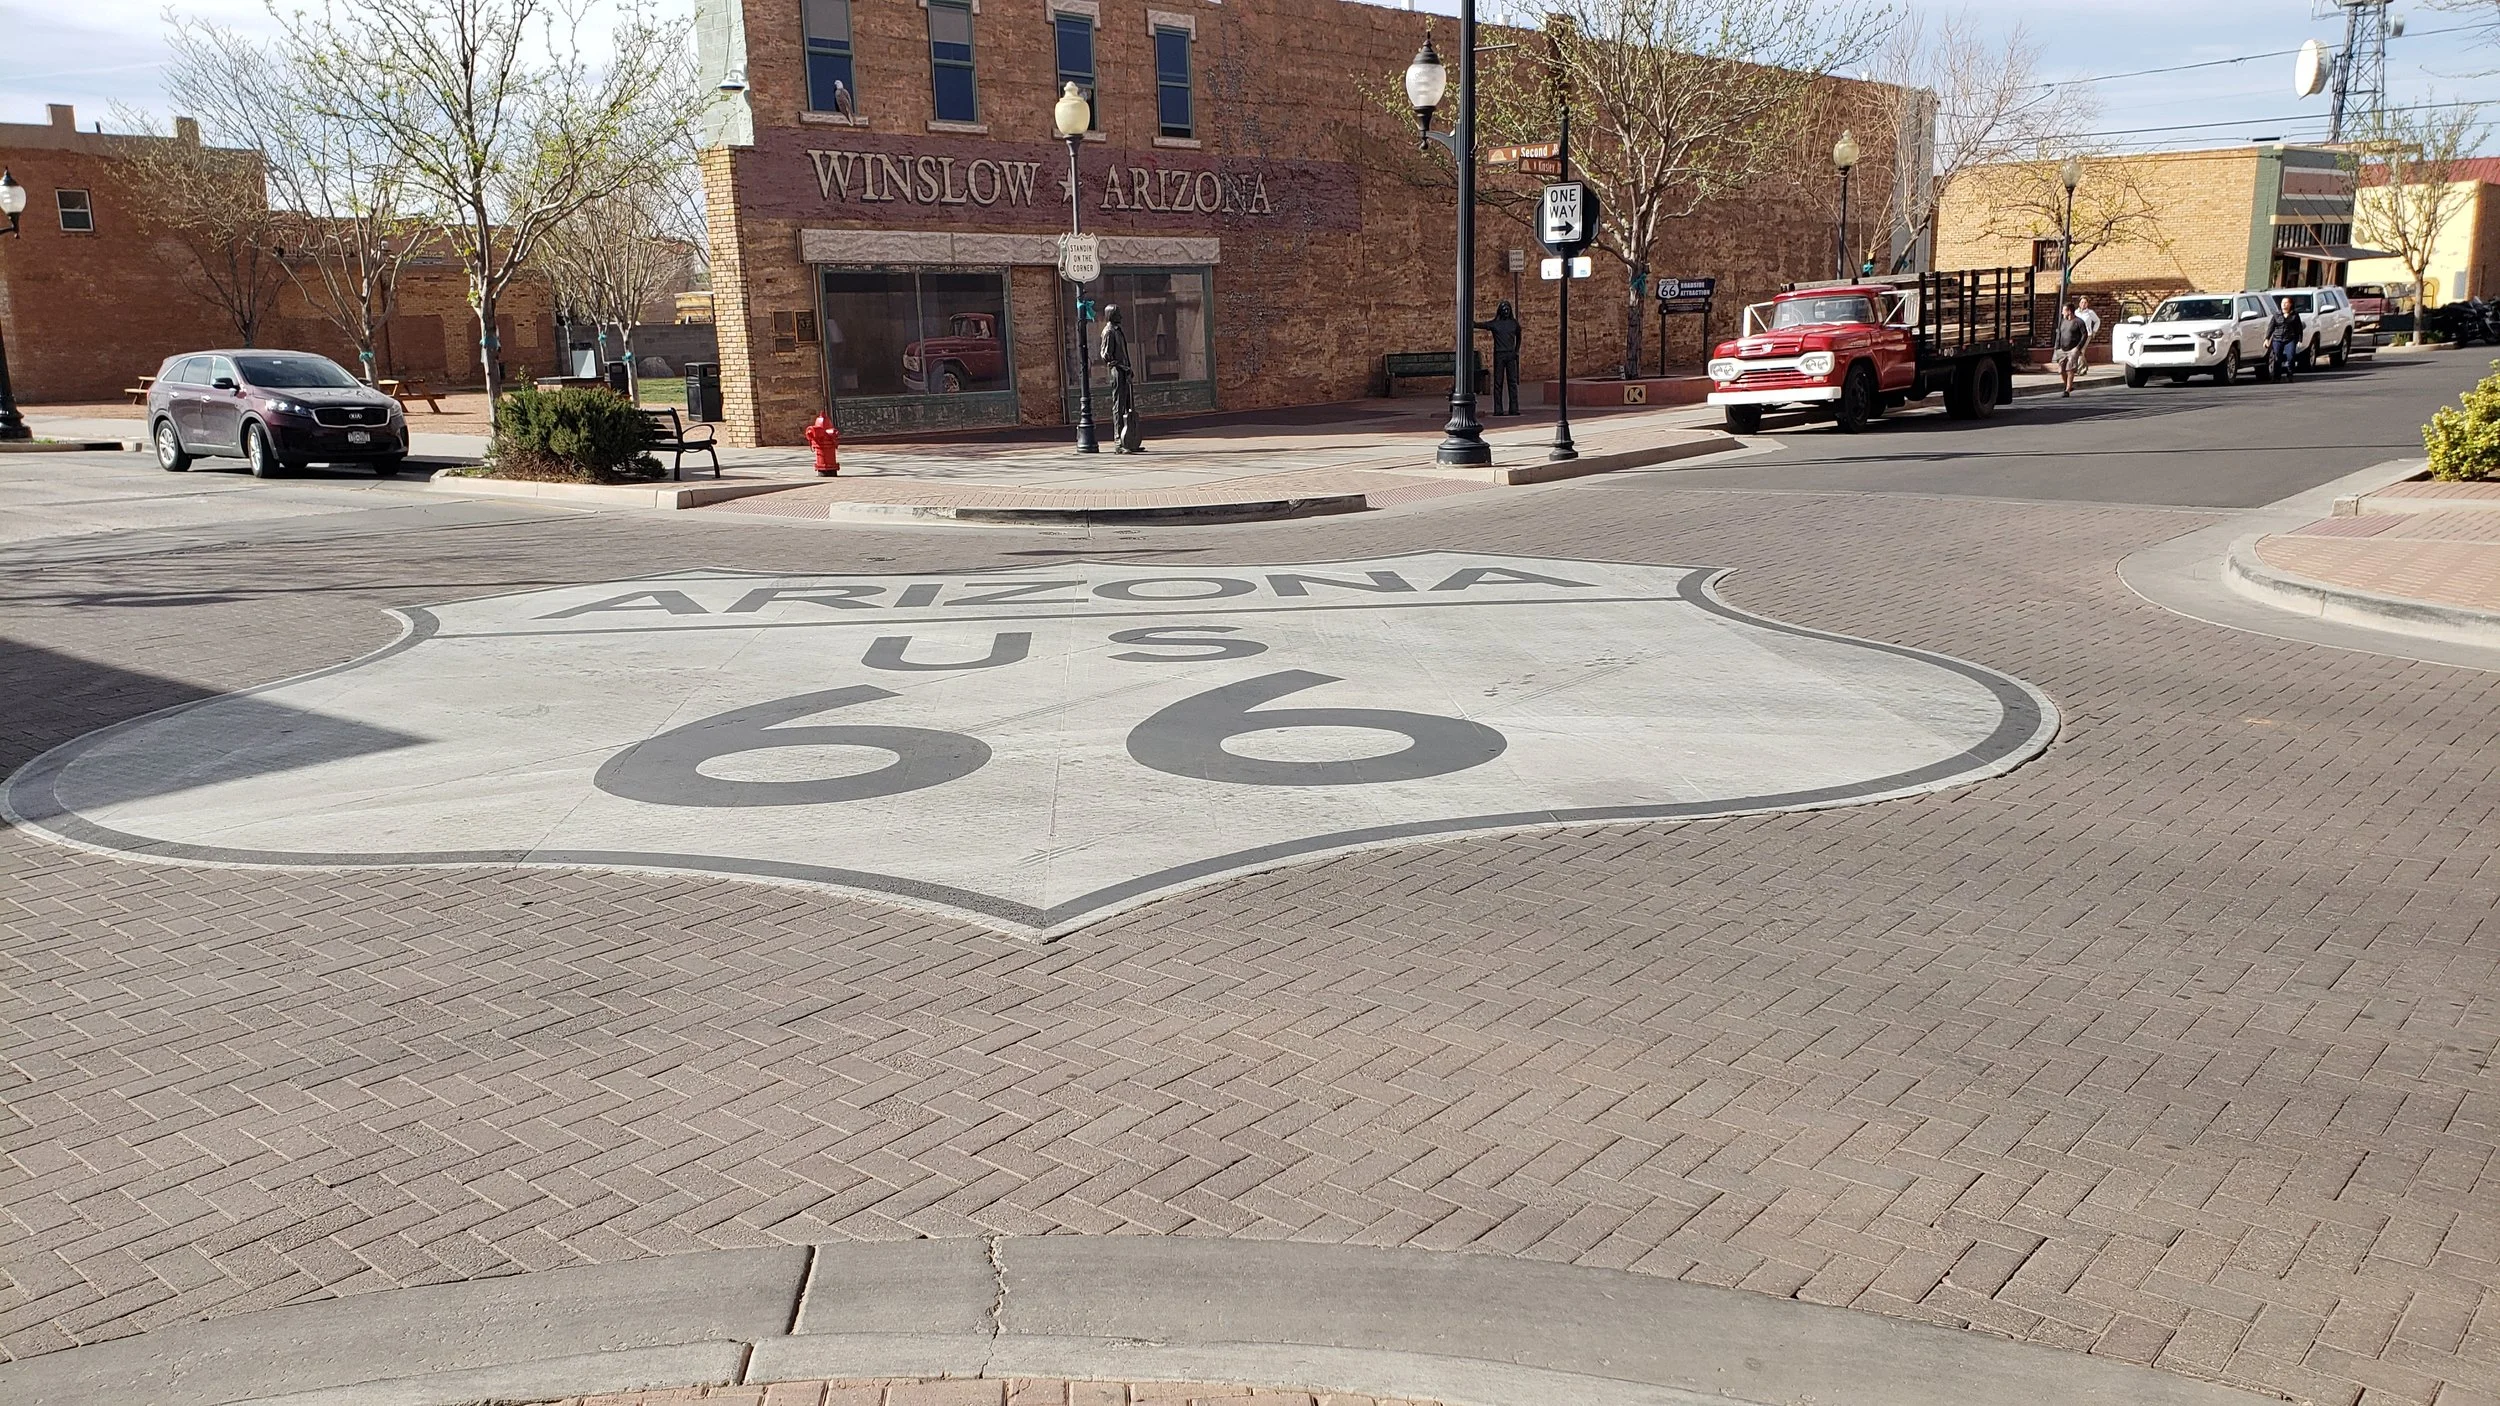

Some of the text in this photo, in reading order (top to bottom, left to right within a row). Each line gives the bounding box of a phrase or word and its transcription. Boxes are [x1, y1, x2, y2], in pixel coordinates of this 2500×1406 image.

[1520, 144, 1548, 158] Second
[806, 149, 1272, 215] WINSLOW ARIZONA
[1550, 188, 1577, 203] ONE
[1549, 204, 1577, 219] WAY
[1661, 286, 1676, 296] 66
[529, 567, 1602, 620] ARIZONA
